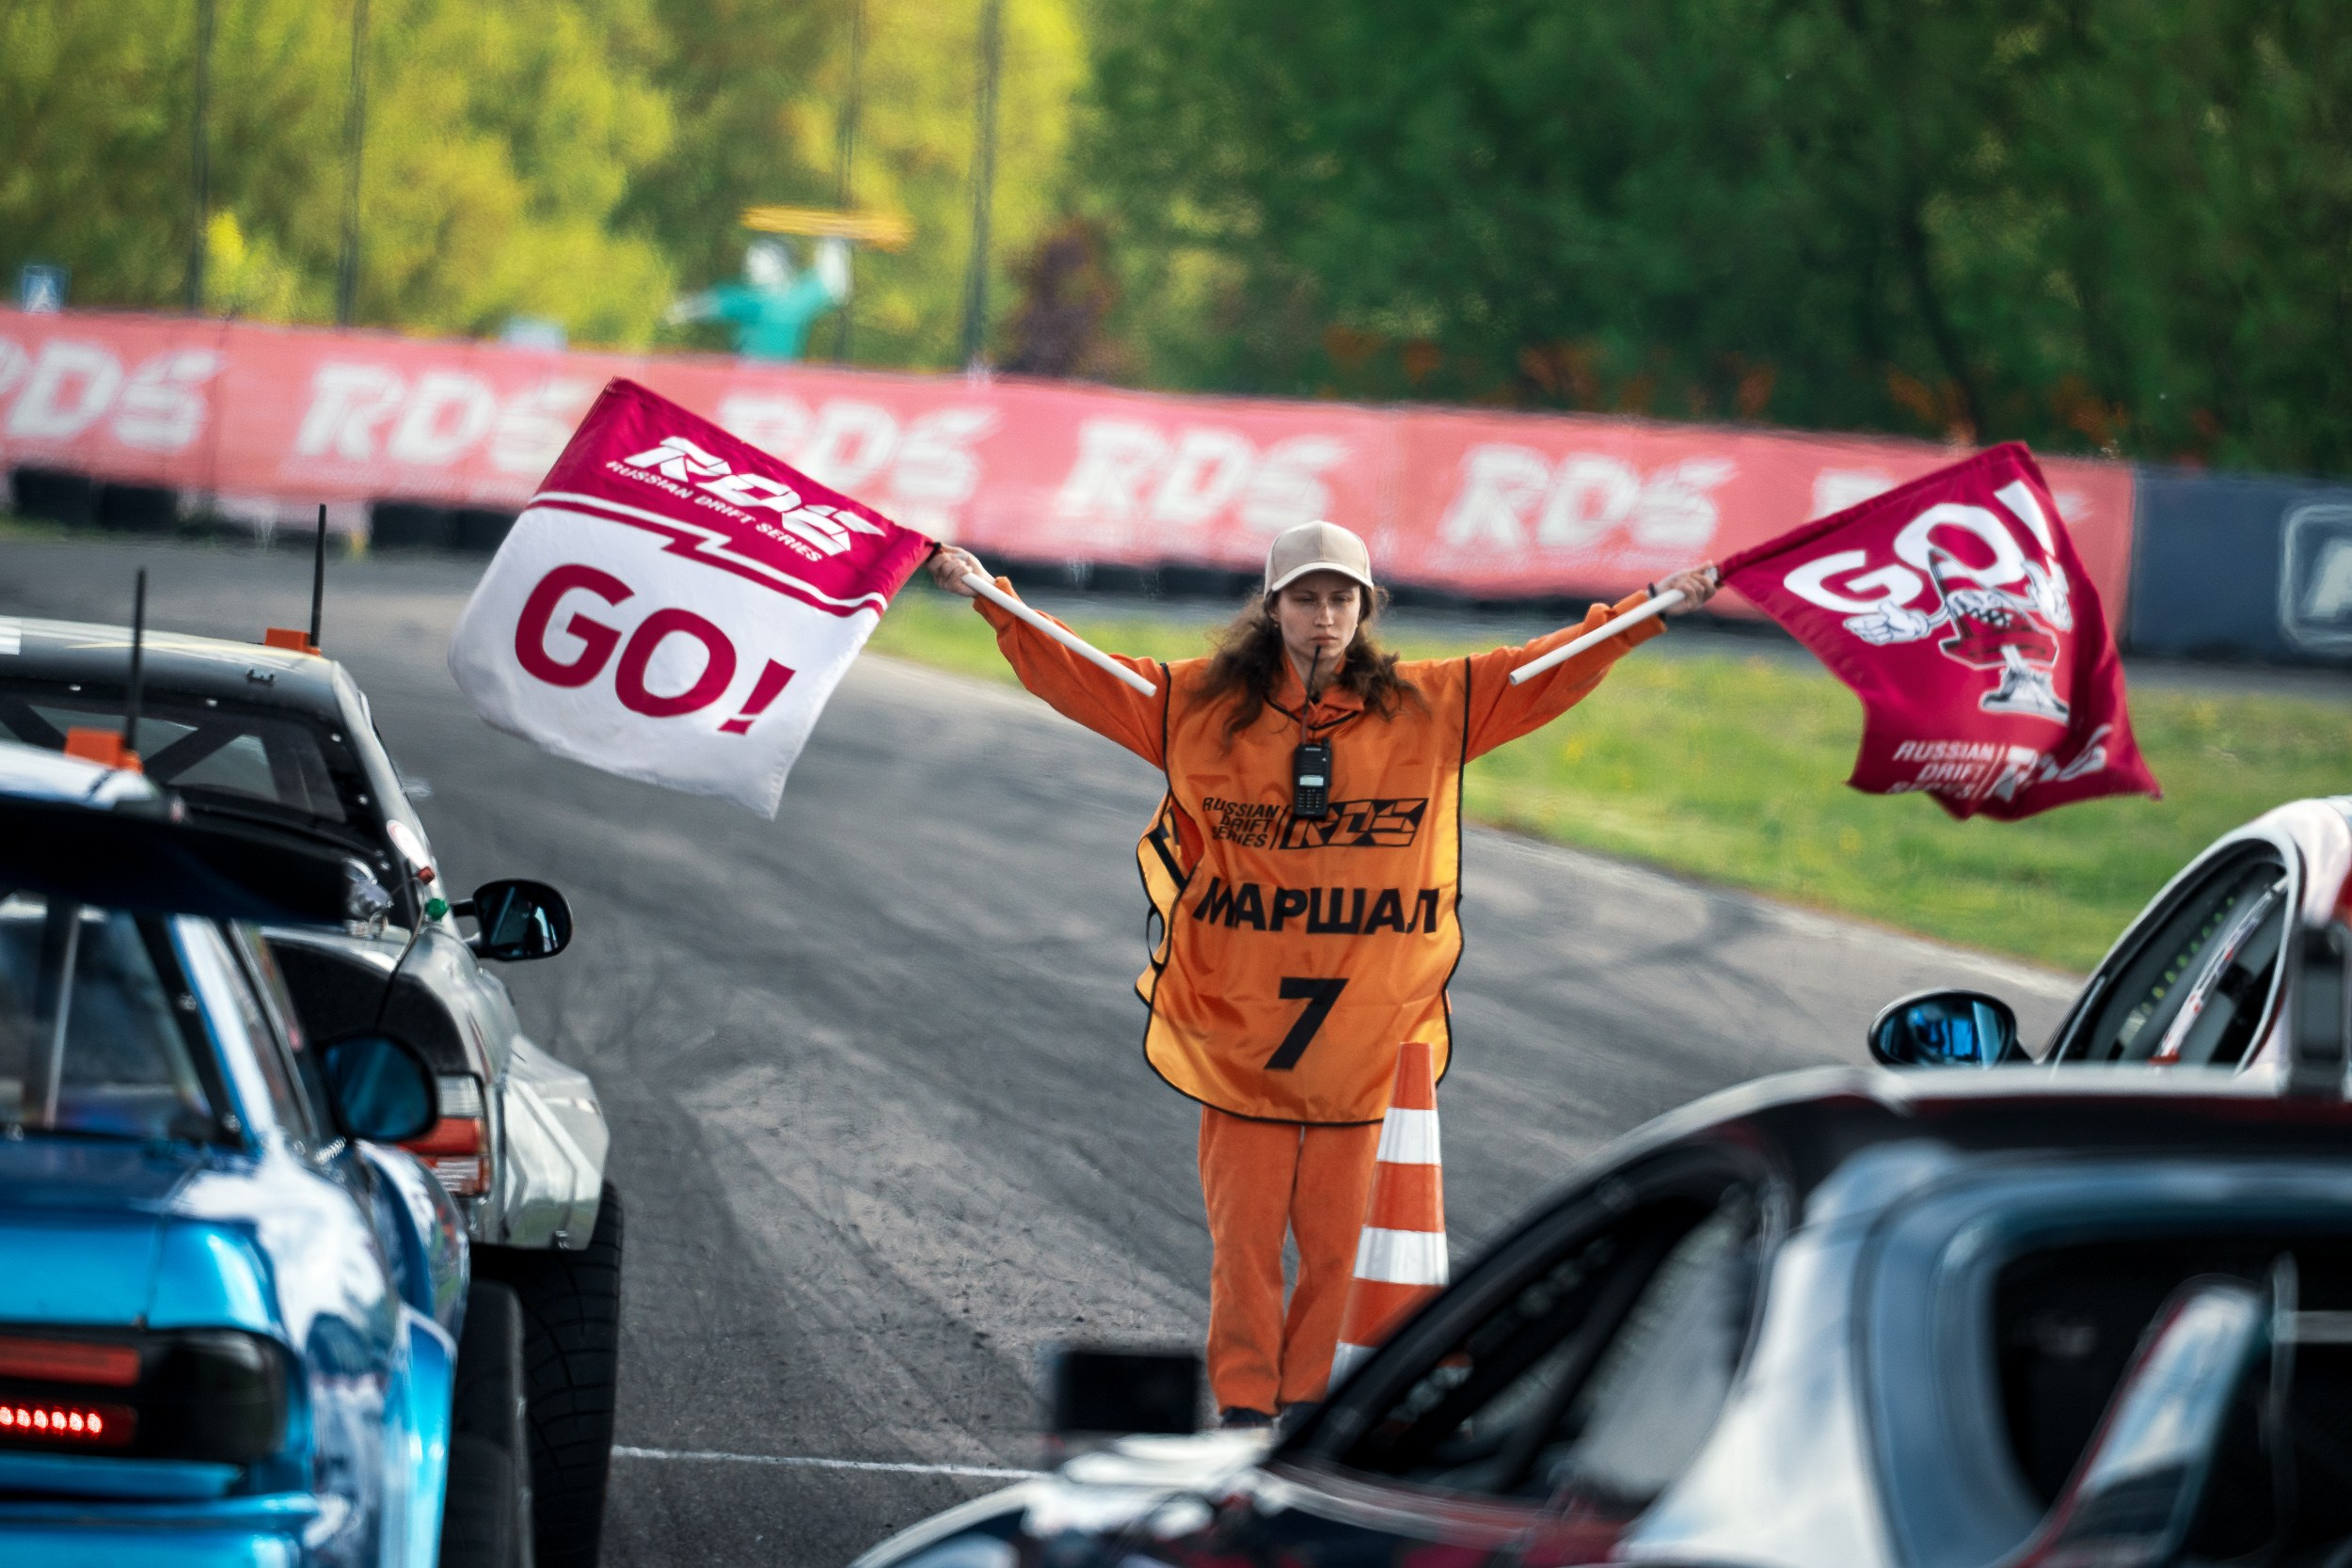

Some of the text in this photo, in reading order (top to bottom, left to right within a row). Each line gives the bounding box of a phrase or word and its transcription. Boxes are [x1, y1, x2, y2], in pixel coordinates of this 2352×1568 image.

[624, 436, 886, 557] RDS
[1056, 416, 1347, 532] RDS
[1439, 442, 1737, 553] RDS
[605, 460, 822, 562] RUSSIAN DRIFT SERIES
[514, 563, 797, 736] GO!
[1892, 739, 1995, 762] RUSSIAN
[1915, 763, 1986, 783] DRIFT
[1201, 797, 1280, 818] RUSSIAN
[1211, 825, 1268, 848] SERIES
[1220, 813, 1274, 832] DRIFT
[1278, 797, 1430, 850] RDS
[1192, 876, 1440, 935] МАРШАЛ
[1263, 976, 1350, 1071] 7
